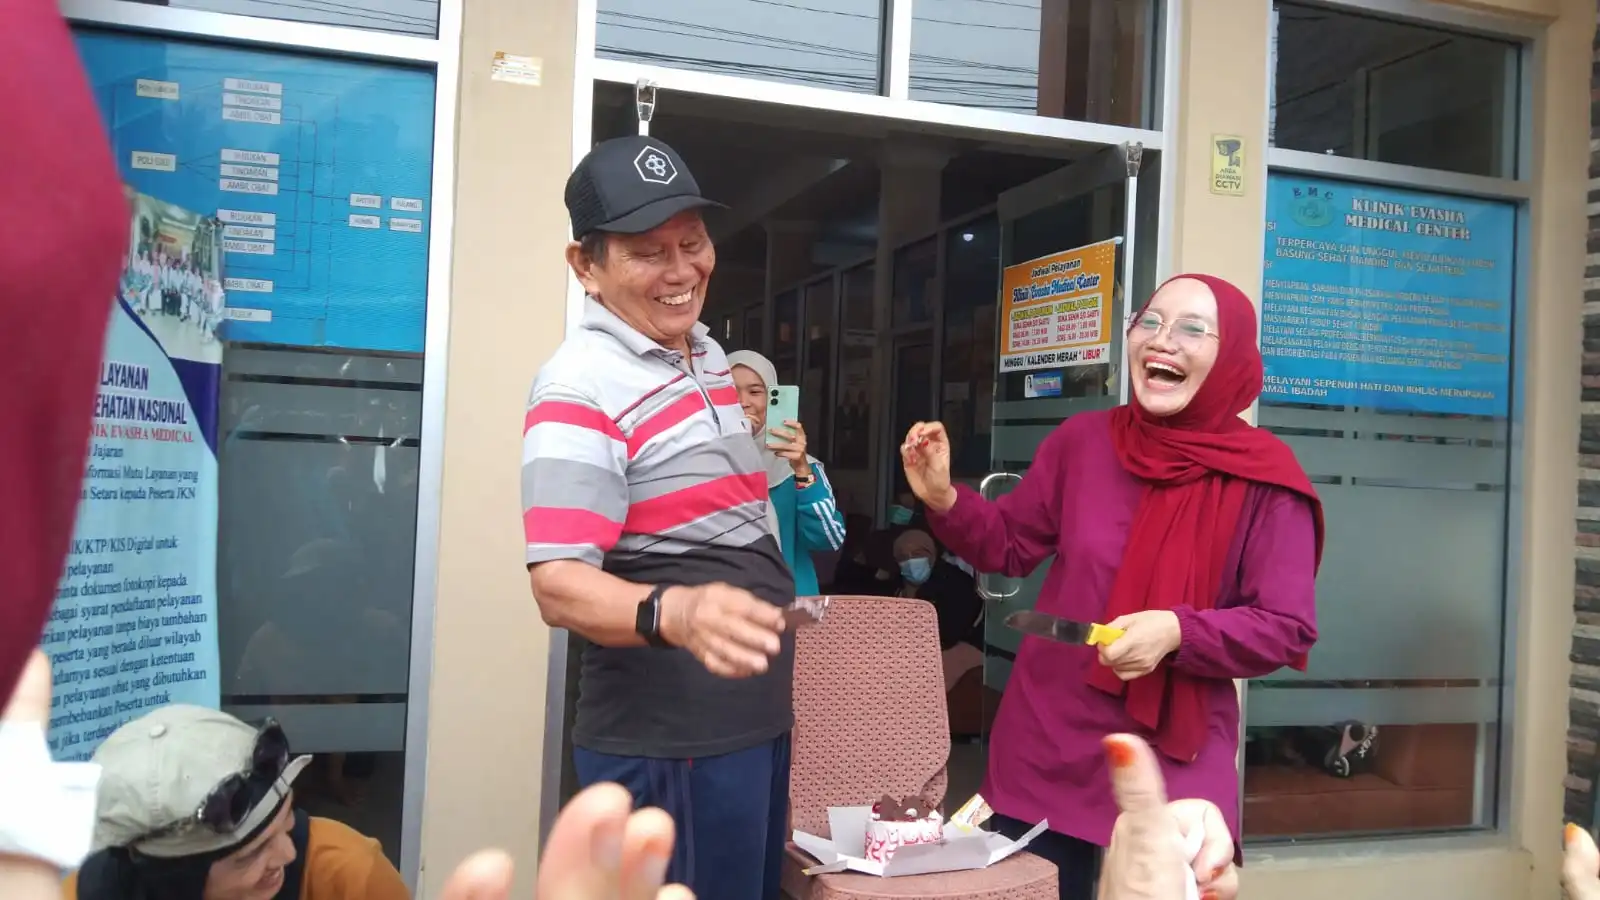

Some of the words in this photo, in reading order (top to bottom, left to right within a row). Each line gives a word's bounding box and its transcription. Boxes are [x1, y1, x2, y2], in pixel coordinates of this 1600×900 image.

[1216, 180, 1240, 190] CCTV
[1352, 198, 1404, 216] KLINIK
[1410, 206, 1465, 224] EVASHA
[1344, 214, 1410, 233] MEDICAL
[1416, 222, 1471, 240] CENTER
[1276, 236, 1337, 251] TERPERCAYA
[1340, 244, 1360, 254] DAN
[1362, 246, 1398, 258] UNGGUL
[1276, 248, 1315, 260] BASUNG
[1318, 252, 1348, 262] SEHAT
[1031, 264, 1050, 278] Jadwal
[1051, 259, 1081, 272] Pelayanan
[1076, 273, 1100, 290] Center
[1004, 357, 1024, 368] MINGGU
[1027, 354, 1056, 366] KALENDER
[1056, 351, 1078, 362] MERAH
[1082, 348, 1100, 360] LIBUR
[1262, 346, 1276, 356] DAN
[101, 362, 149, 390] LAYANAN
[1263, 374, 1311, 387] MELAYANI
[1314, 378, 1358, 390] SEPENUH
[1360, 382, 1382, 392] HATI
[1384, 384, 1404, 394] DAN
[1406, 385, 1438, 396] IKHLAS
[1261, 384, 1288, 394] AMAL
[1291, 386, 1328, 397] IBADAH
[137, 399, 188, 424] NASIONAL
[110, 425, 148, 442] EVASHA
[151, 428, 194, 443] MEDICAL
[92, 444, 124, 460] Jajaran
[123, 465, 144, 480] Mutu
[145, 466, 177, 482] Layanan
[178, 470, 198, 483] yang
[91, 486, 118, 500] Setara
[120, 487, 146, 503] kepada
[149, 488, 176, 500] Peserta
[176, 487, 196, 500] JKN
[127, 535, 155, 554] Digital
[156, 535, 178, 550] untuk
[68, 561, 114, 580] pelayanan
[80, 582, 122, 597] dokumen
[122, 577, 156, 593] fotokopi
[157, 573, 188, 591] kepada
[80, 604, 109, 621] syarat
[110, 596, 156, 620] pendaftaran
[156, 594, 203, 612] pelayanan
[68, 624, 114, 645] pelayanan
[137, 614, 160, 631] biaya
[162, 610, 208, 626] tambahan
[52, 650, 85, 668] peserta
[86, 646, 110, 662] yang
[111, 640, 137, 655] berada
[138, 636, 162, 650] diluar
[164, 630, 202, 648] wilayah
[93, 663, 119, 680] sesuai
[120, 657, 149, 674] dengan
[150, 652, 196, 668] ketentuan
[63, 686, 111, 706] pelayanan
[130, 678, 152, 692] yang
[152, 668, 206, 687] dibutuhkan
[114, 698, 144, 716] Peserta
[144, 690, 171, 706] untuk
[61, 732, 80, 752] jika
